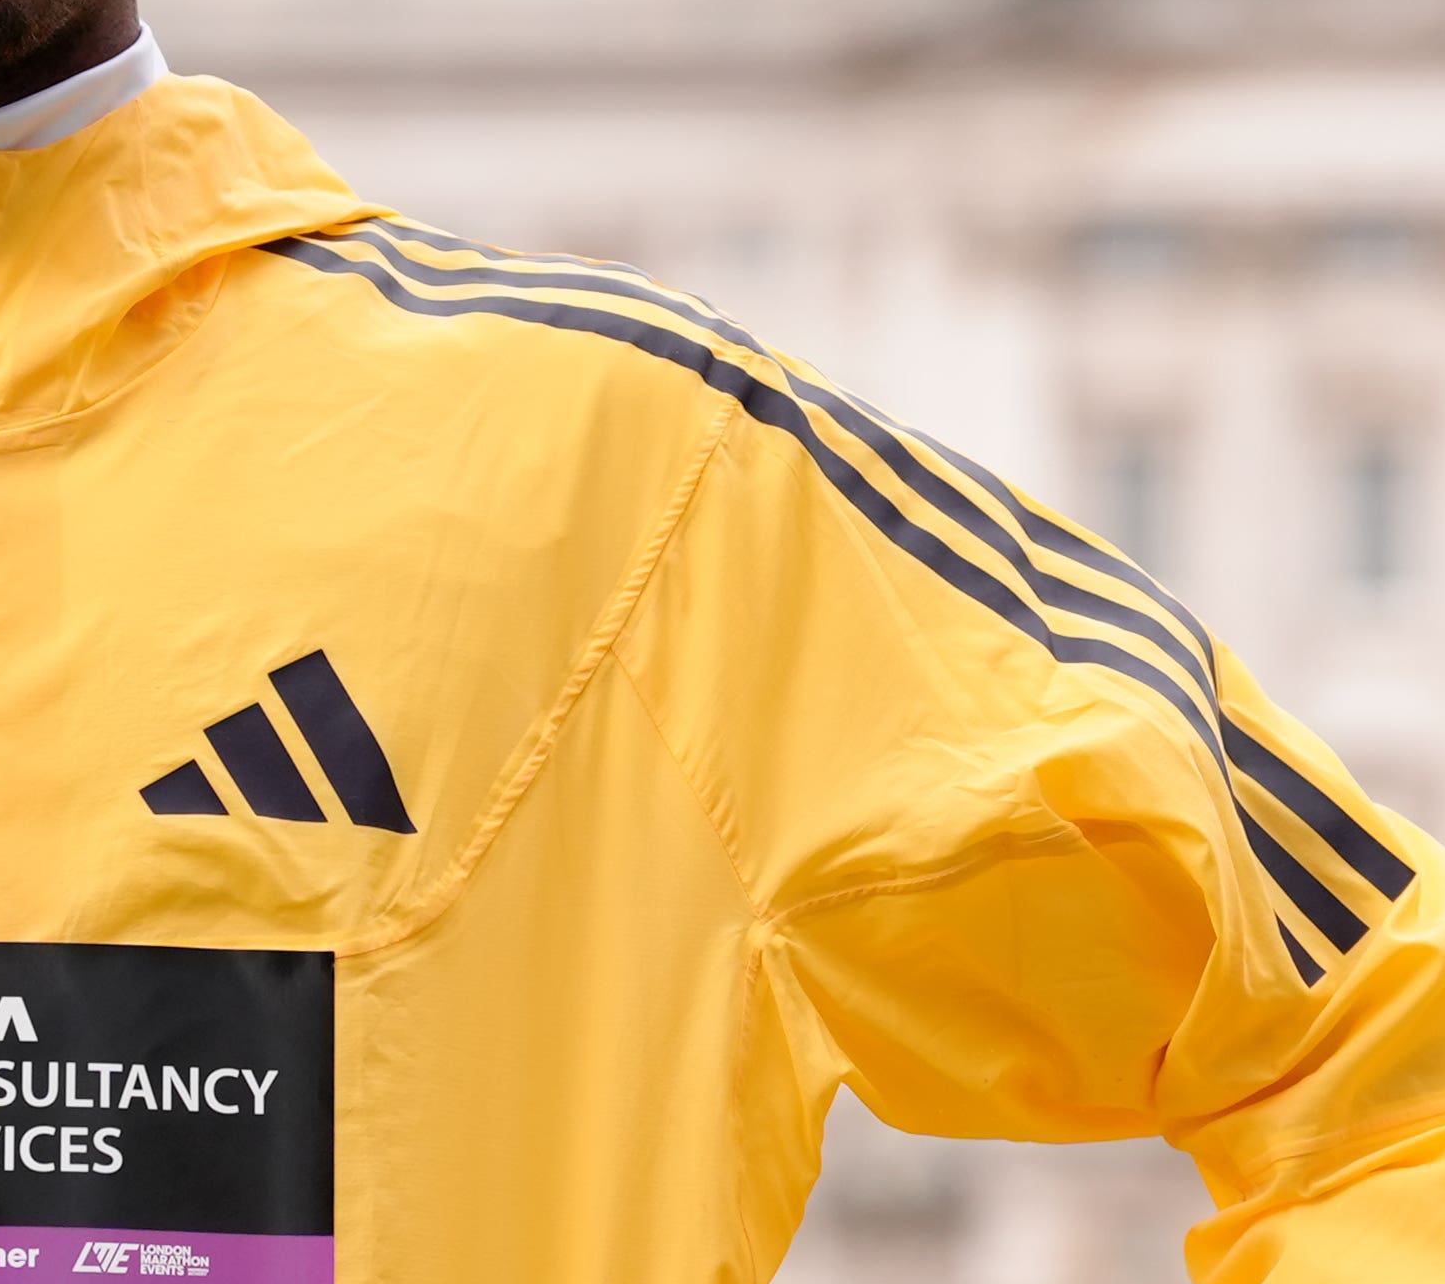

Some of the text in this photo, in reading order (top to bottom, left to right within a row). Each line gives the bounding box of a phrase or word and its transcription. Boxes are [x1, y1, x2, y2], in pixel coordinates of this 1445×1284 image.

[140, 1244, 191, 1257] LONDON
[140, 1254, 210, 1268] MARATHON
[140, 1265, 185, 1276] EVENTS
